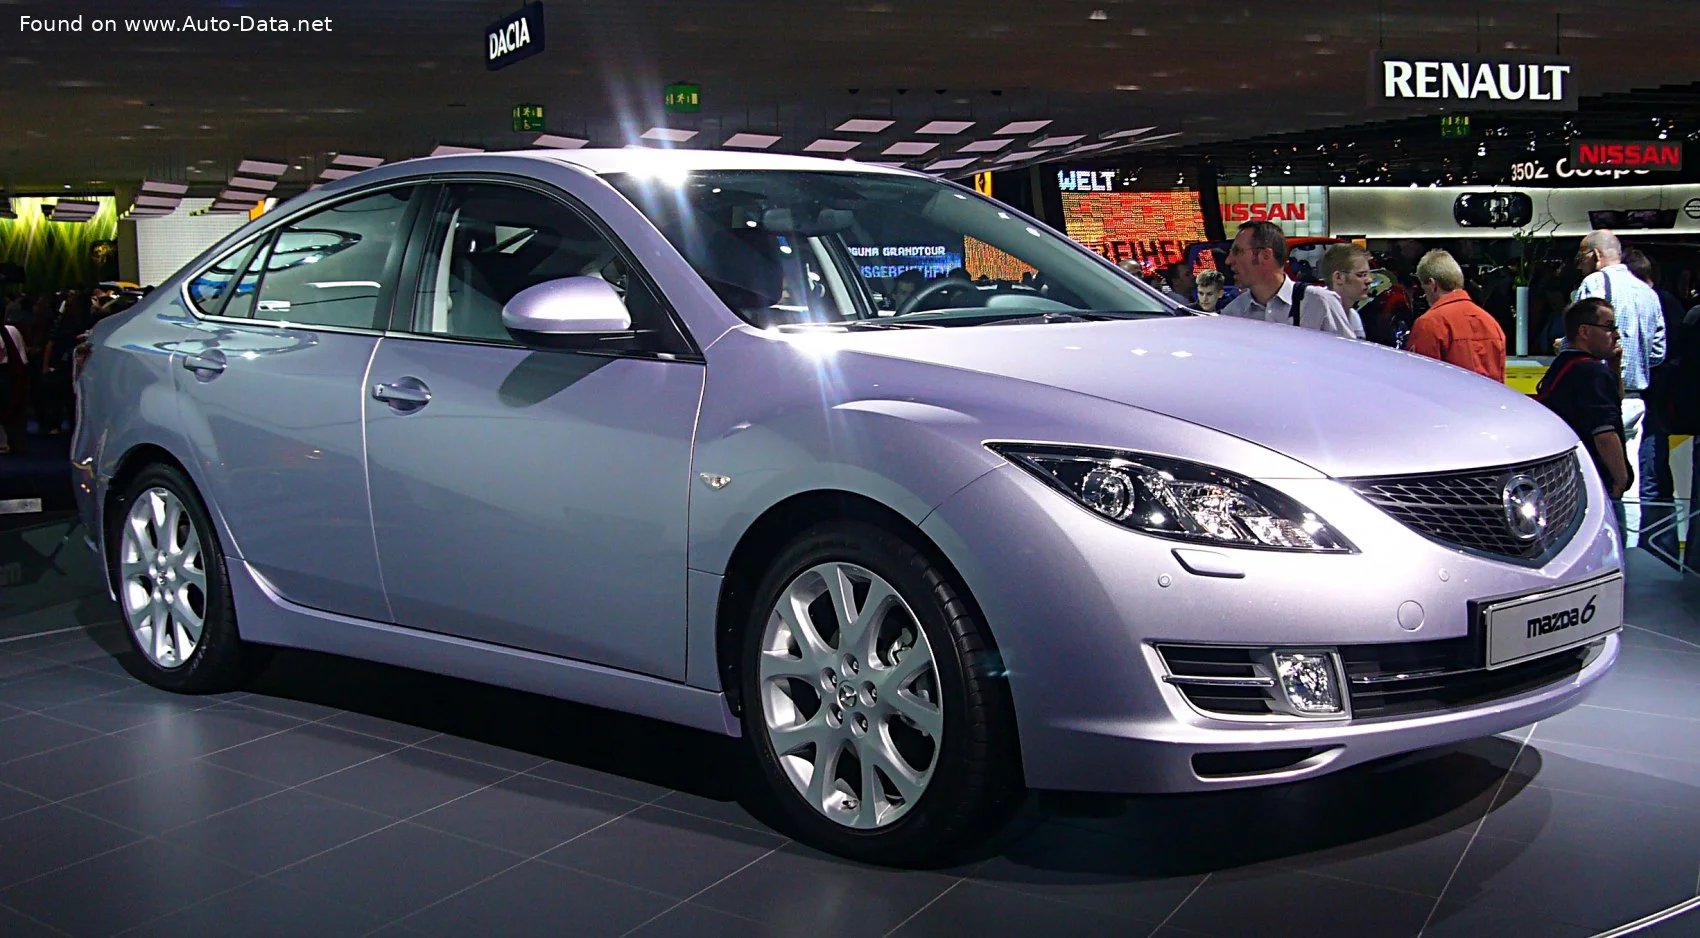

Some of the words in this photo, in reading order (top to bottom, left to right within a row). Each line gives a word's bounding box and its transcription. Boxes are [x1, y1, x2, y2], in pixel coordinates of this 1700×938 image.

[489, 17, 531, 60] DACIA
[1383, 61, 1571, 100] RENAULT
[1579, 143, 1679, 166] NISSAN
[1057, 170, 1116, 191] WELT
[882, 246, 946, 257] GRANDTOUR
